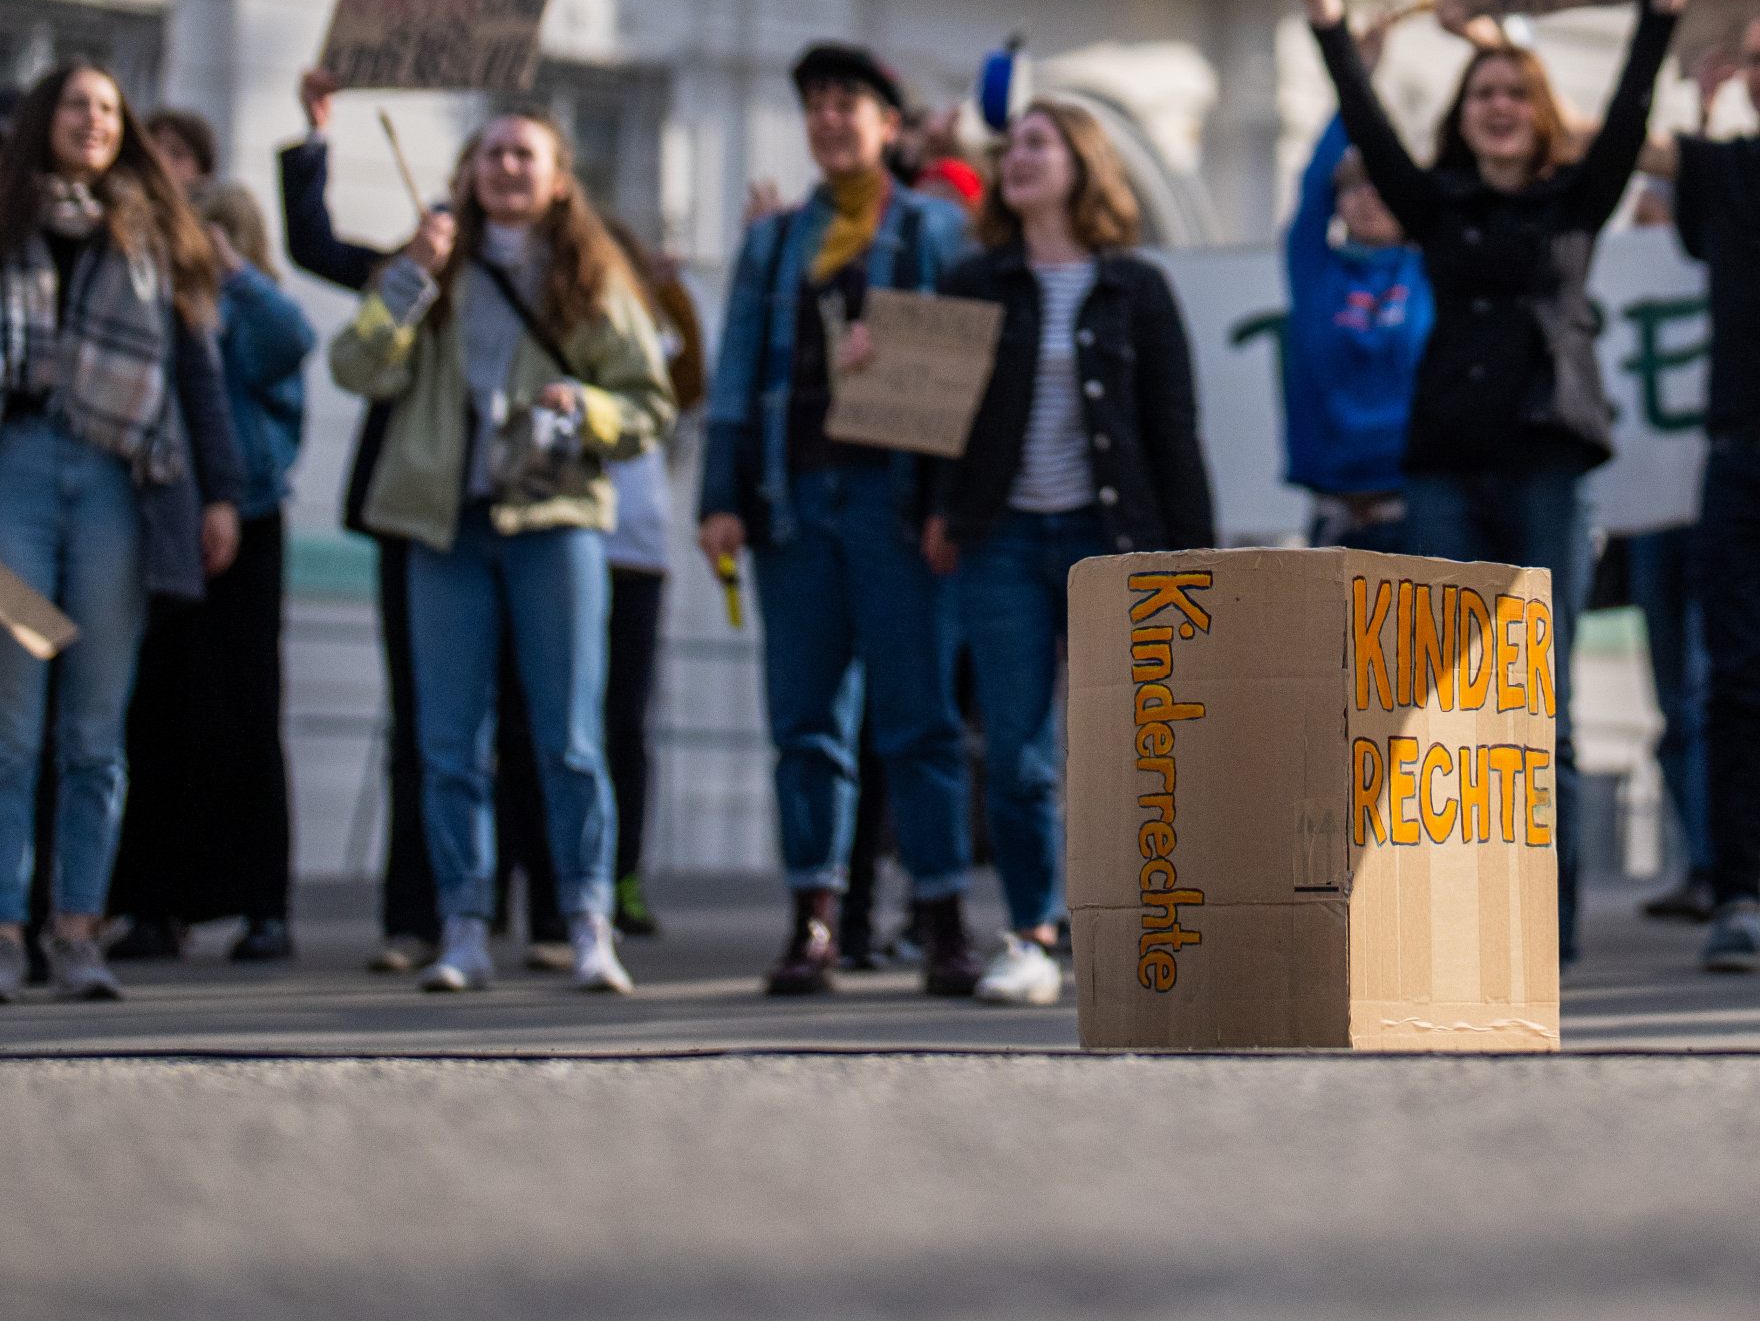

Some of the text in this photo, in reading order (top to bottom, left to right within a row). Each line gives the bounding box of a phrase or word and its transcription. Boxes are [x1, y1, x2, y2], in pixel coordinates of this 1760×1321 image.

[1352, 575, 1557, 718] KINDER
[1128, 570, 1213, 994] Kinderrechte
[1352, 736, 1553, 848] RECHTE
